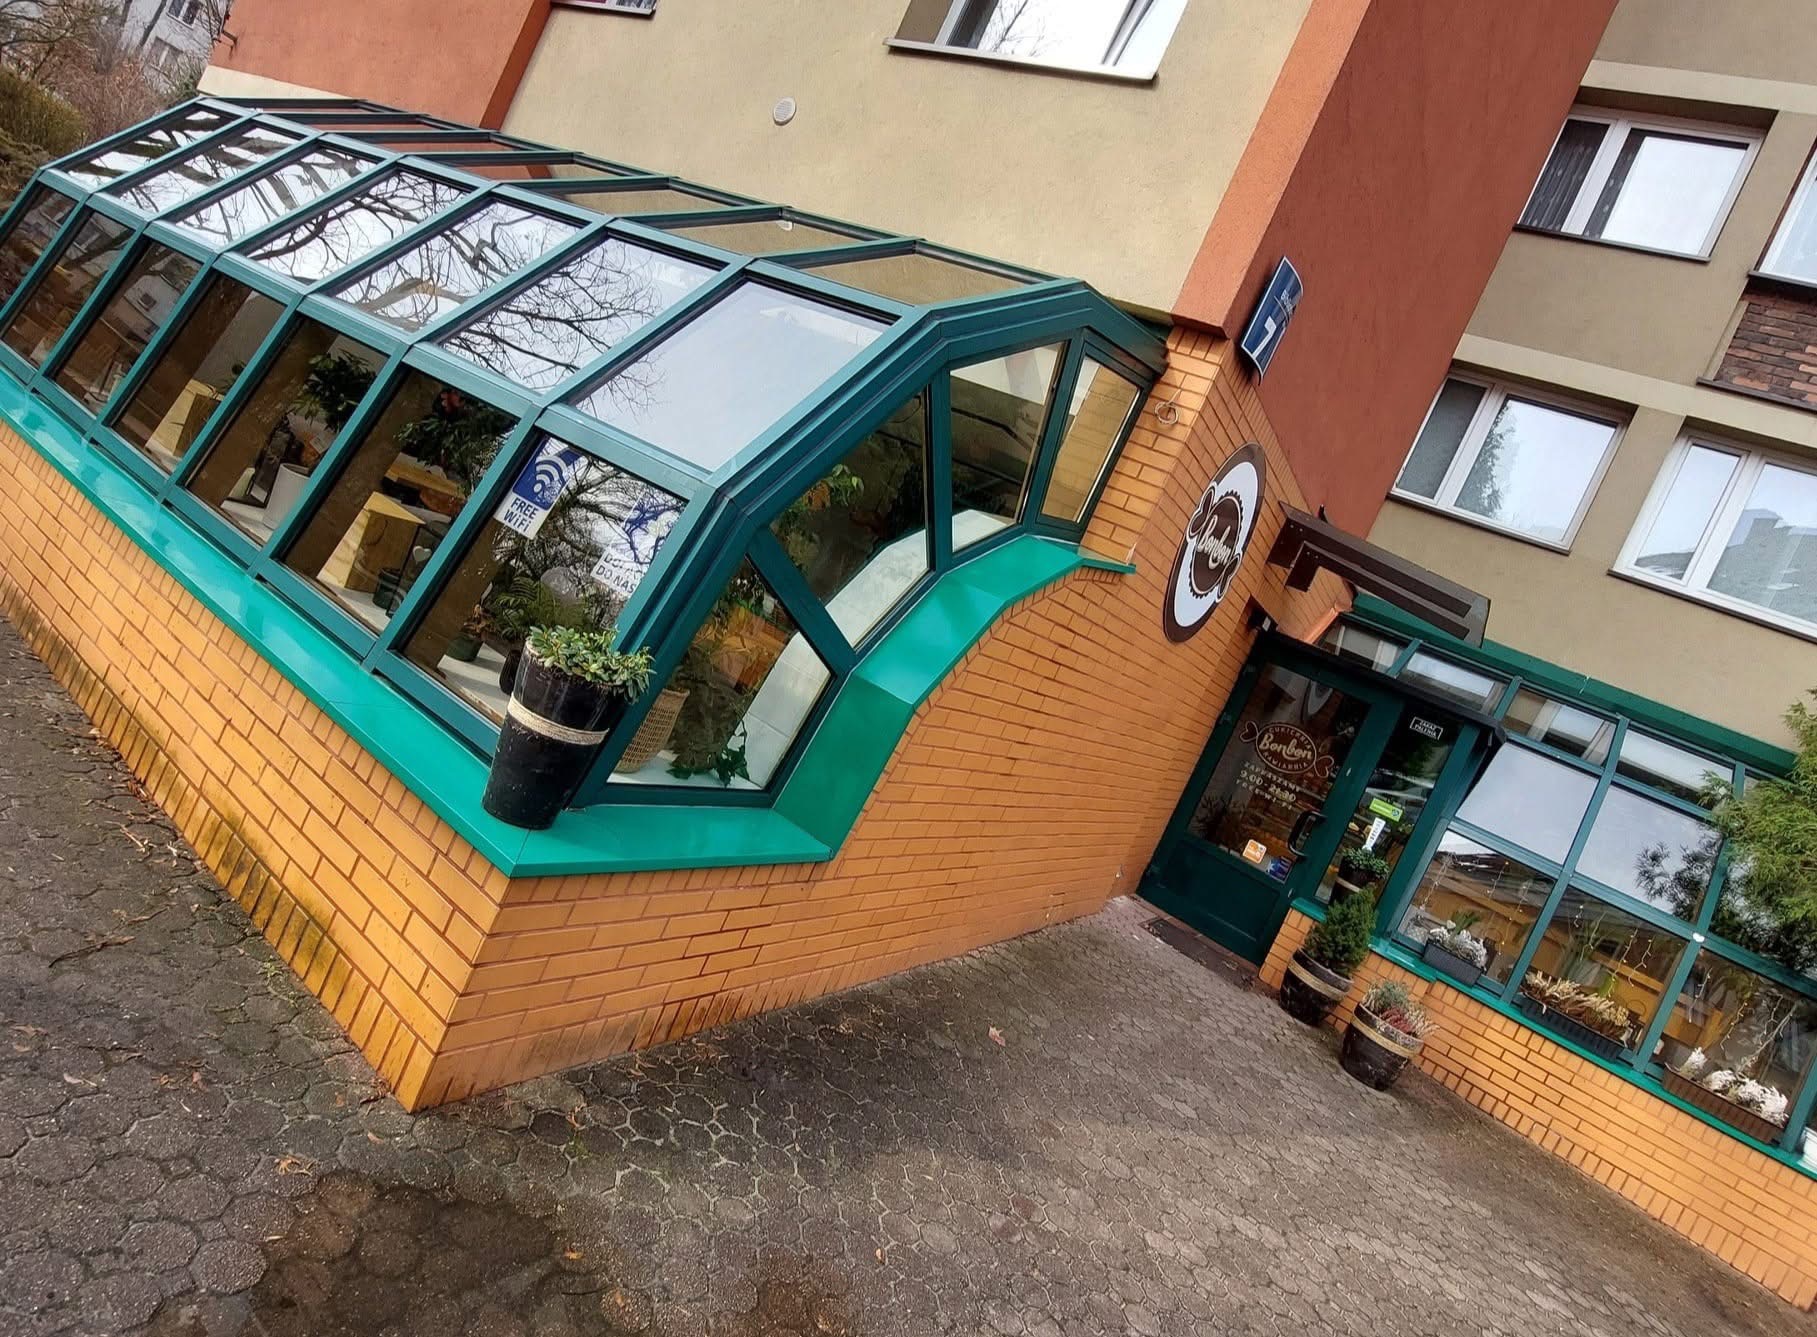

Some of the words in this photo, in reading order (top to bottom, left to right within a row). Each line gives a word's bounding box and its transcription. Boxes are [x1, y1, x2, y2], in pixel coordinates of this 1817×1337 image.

[503, 508, 532, 533] WiFi
[510, 498, 539, 520] FREE
[1197, 514, 1232, 570] Bonbon
[595, 565, 613, 580] DO
[614, 576, 637, 594] NAS
[1258, 733, 1313, 761] Bonbon
